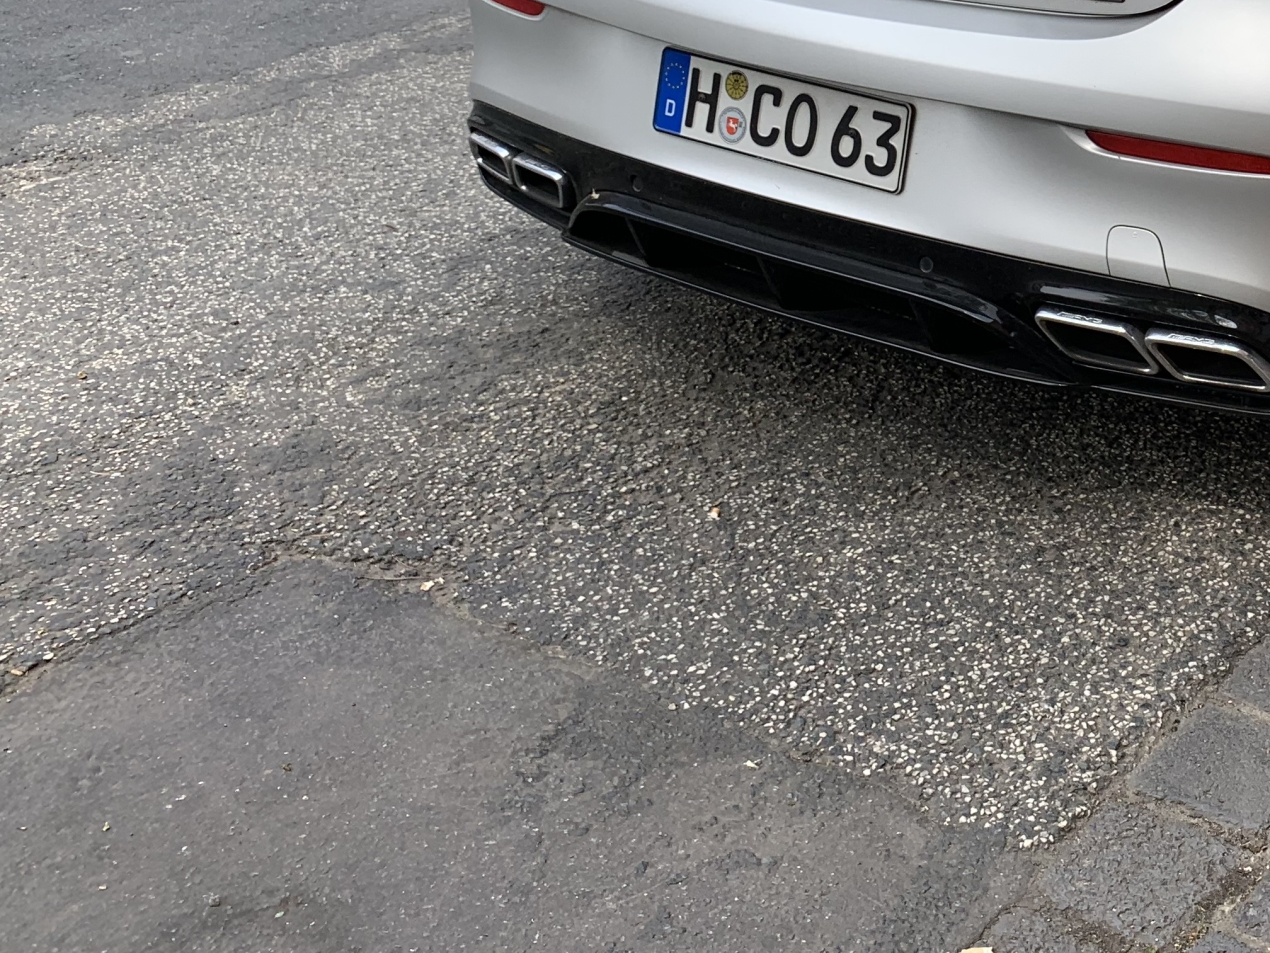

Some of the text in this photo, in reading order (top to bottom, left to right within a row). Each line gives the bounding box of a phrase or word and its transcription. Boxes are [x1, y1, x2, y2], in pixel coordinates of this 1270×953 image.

[665, 98, 677, 118] D
[684, 67, 902, 177] H CO 63
